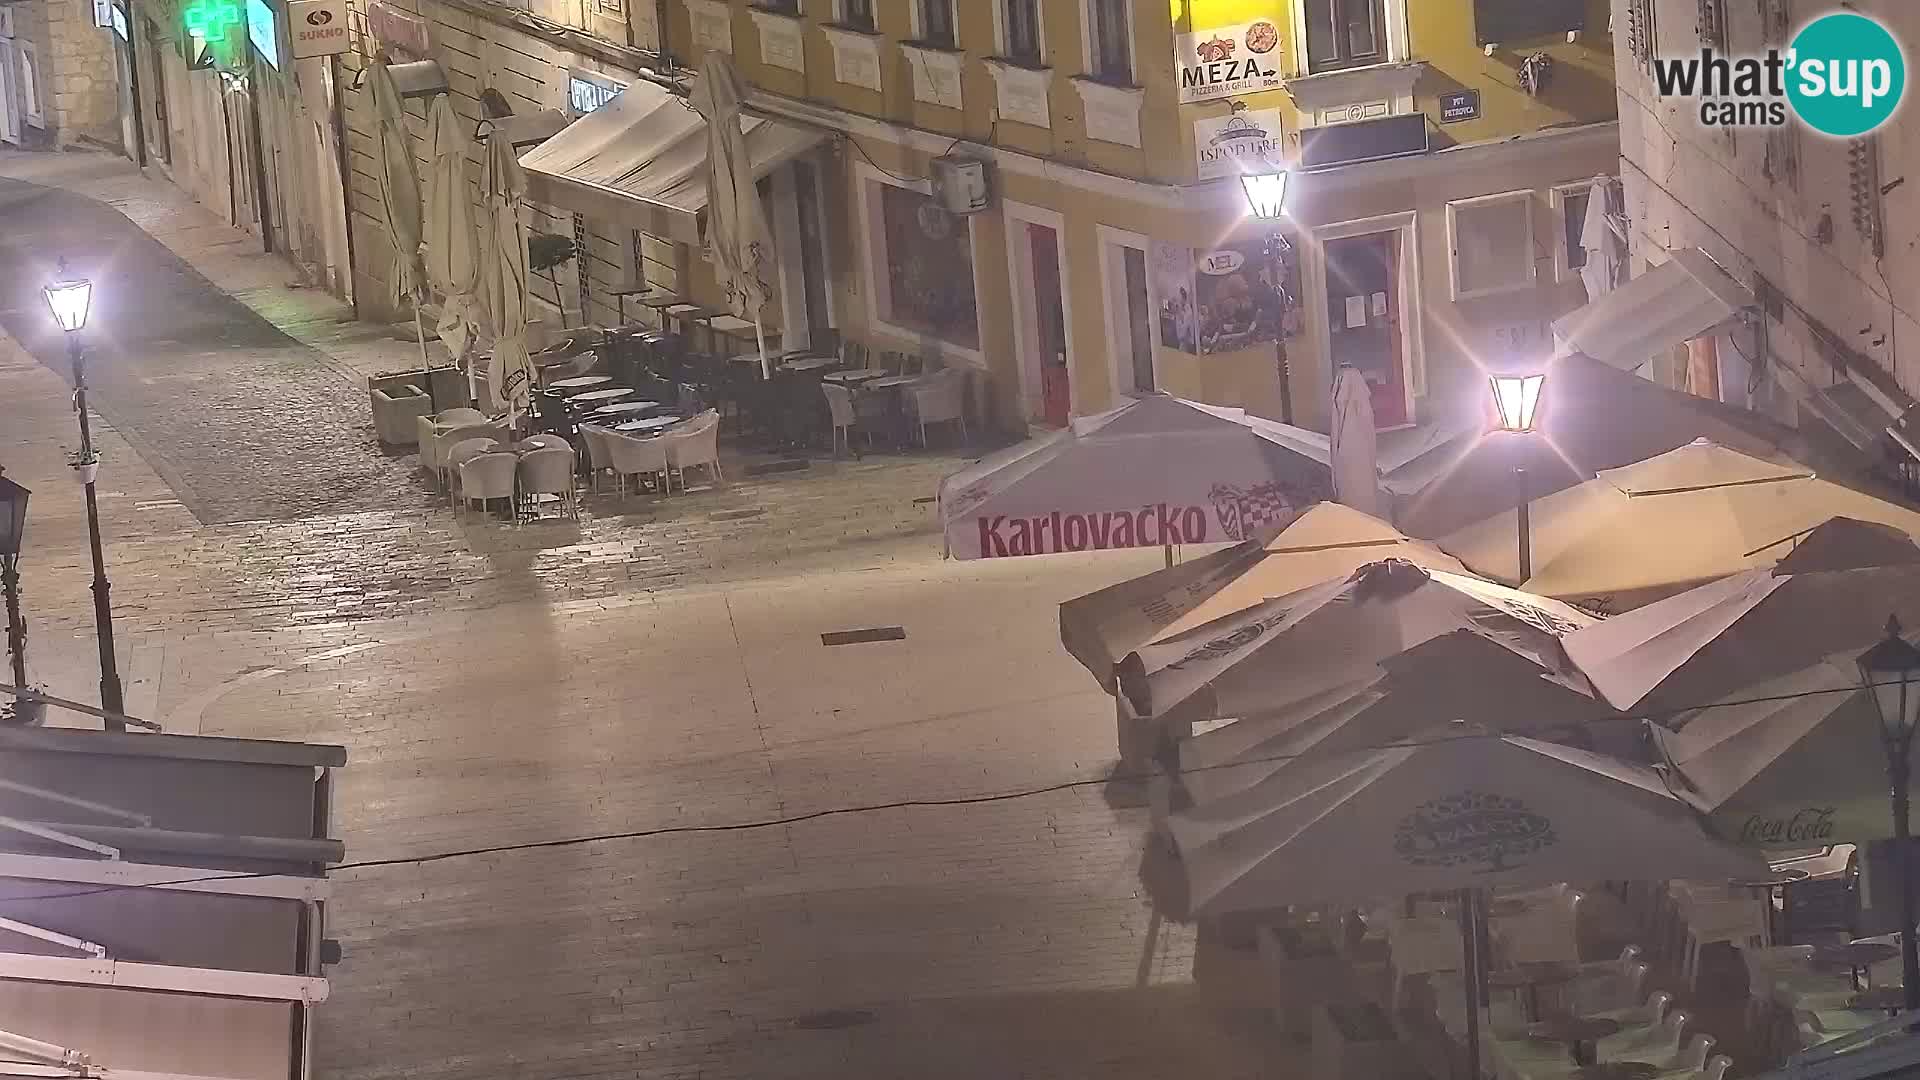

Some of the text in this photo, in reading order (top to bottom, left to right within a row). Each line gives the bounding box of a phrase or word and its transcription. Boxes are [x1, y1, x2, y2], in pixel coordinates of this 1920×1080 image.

[299, 27, 344, 41] SUKNO
[1182, 58, 1261, 88] MEZA
[1192, 80, 1253, 97] PIZZERIA & GRILL
[977, 503, 1207, 559] Karlovačko
